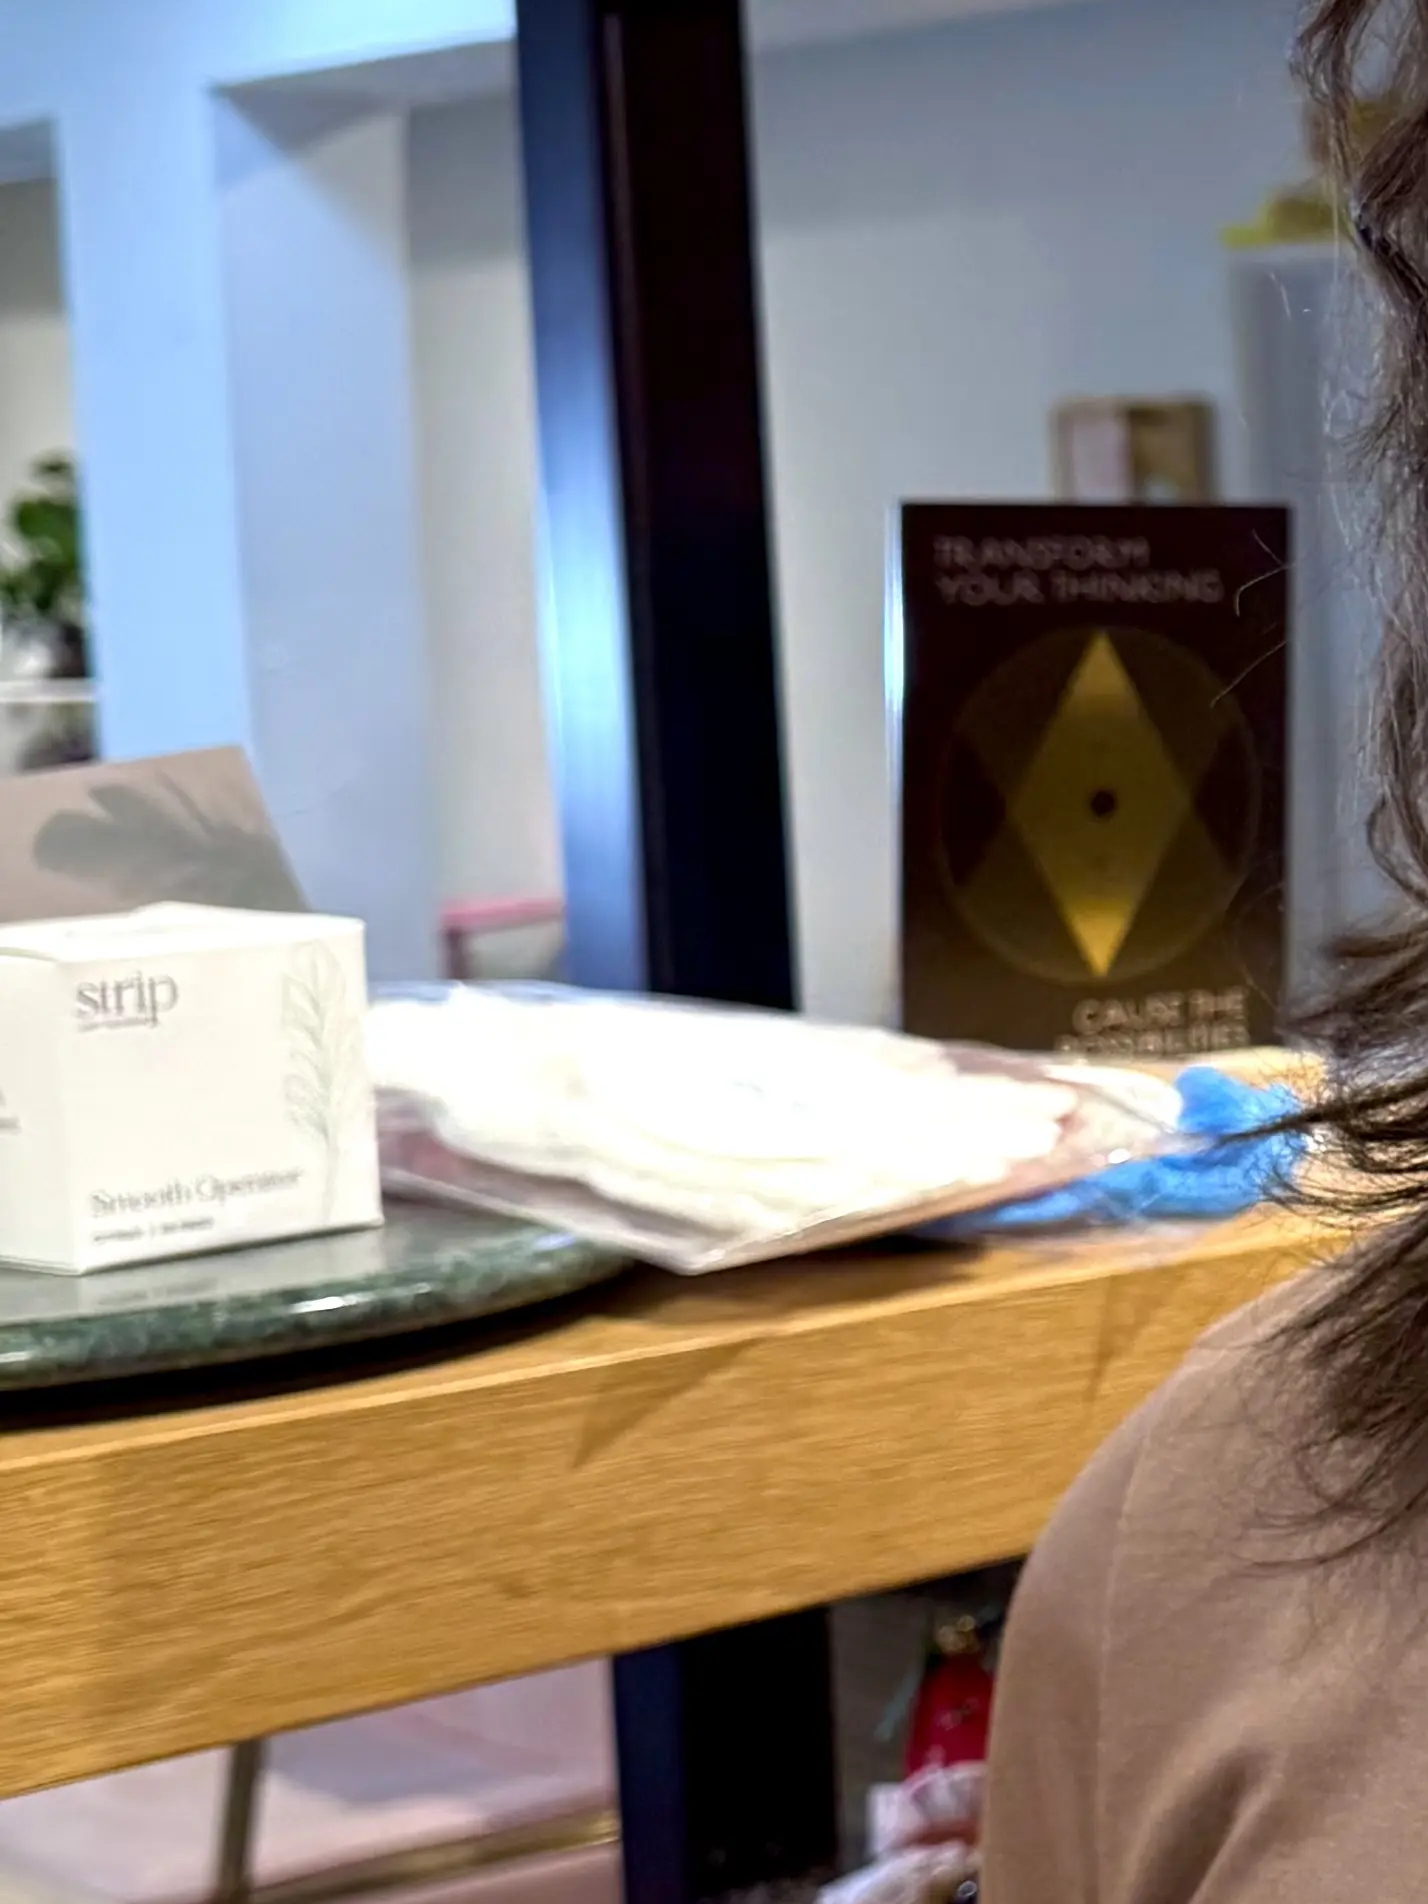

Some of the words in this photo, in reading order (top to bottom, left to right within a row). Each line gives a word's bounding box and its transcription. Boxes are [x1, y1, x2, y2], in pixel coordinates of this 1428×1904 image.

[933, 568, 1045, 606] YOUR
[1050, 567, 1226, 604] THINKING
[71, 969, 180, 1028] strip
